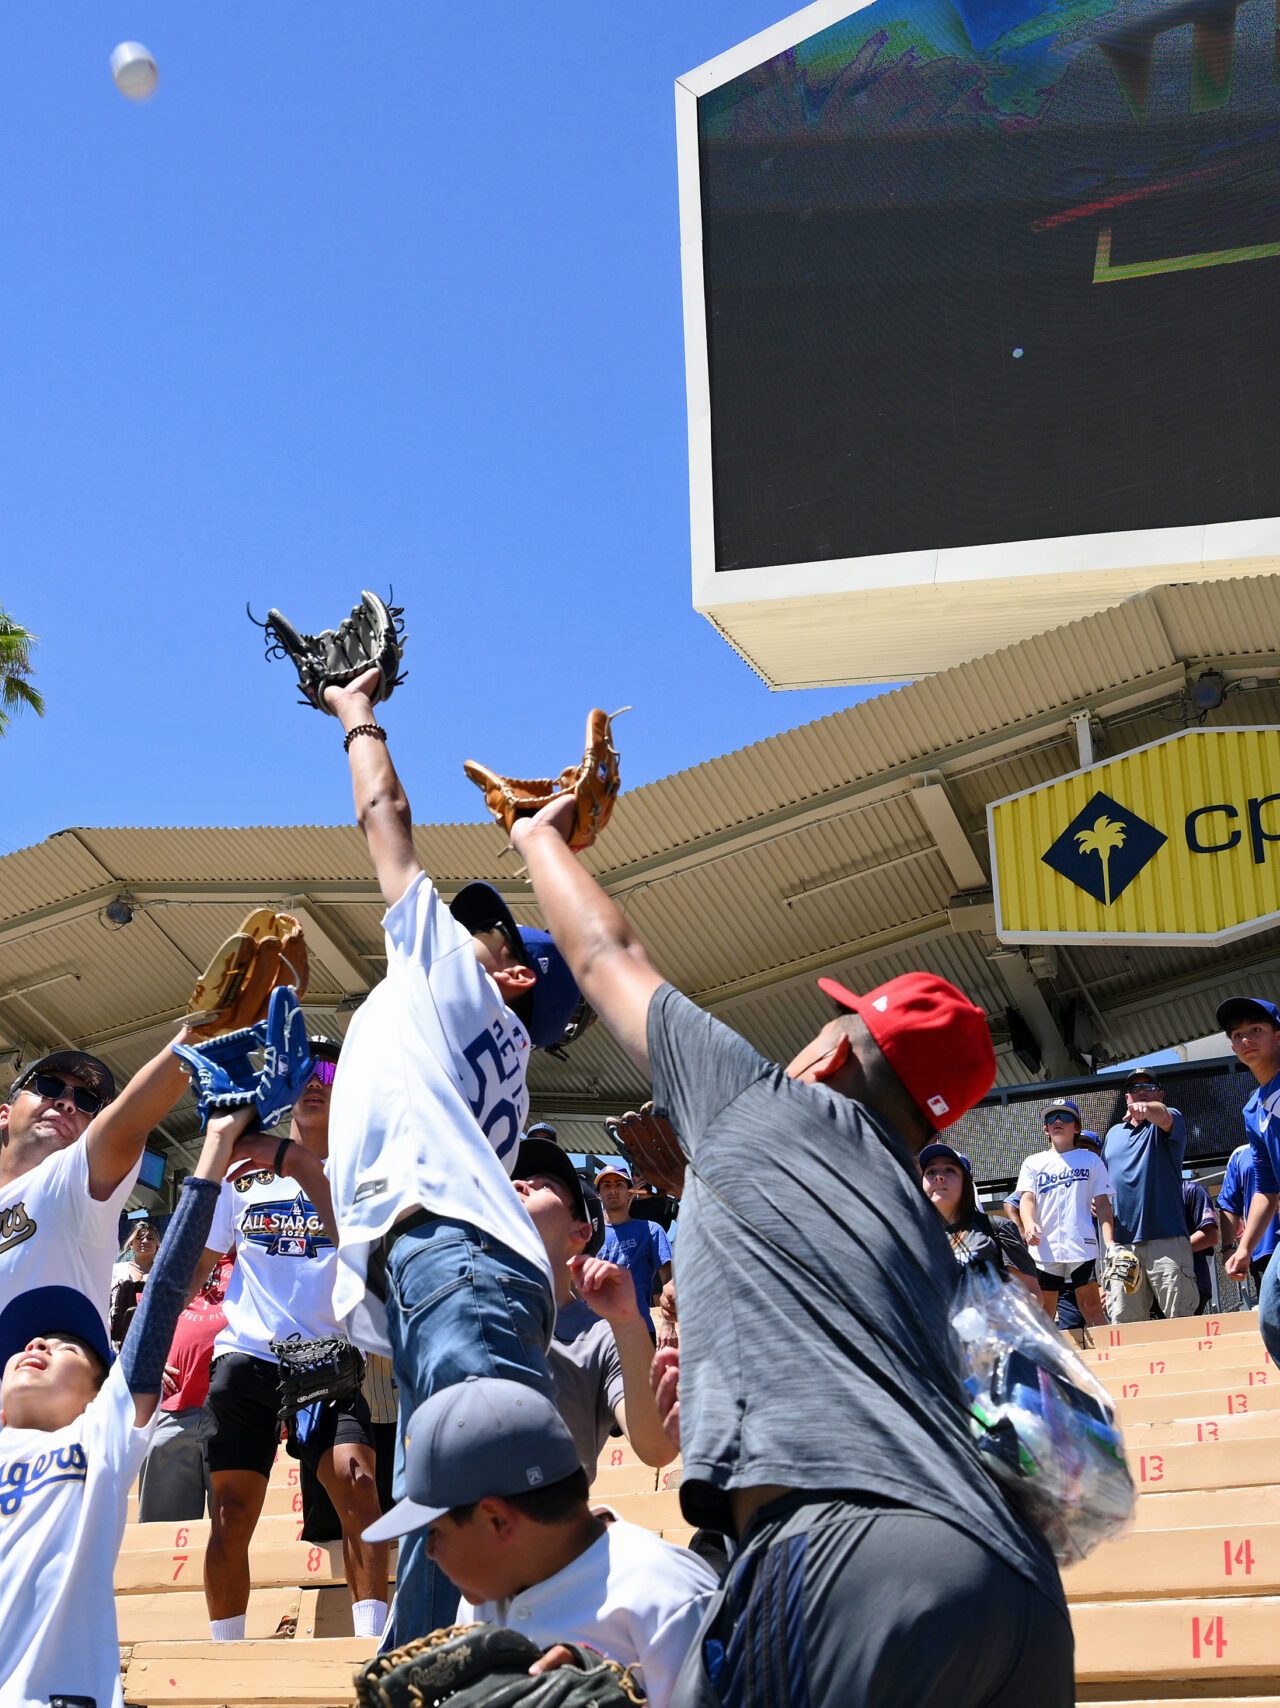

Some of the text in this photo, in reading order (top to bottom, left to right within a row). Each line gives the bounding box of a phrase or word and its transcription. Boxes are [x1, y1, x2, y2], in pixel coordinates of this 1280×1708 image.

[463, 1028, 518, 1160] 50
[1038, 1166, 1090, 1194] Dodgers
[243, 1214, 266, 1230] ALL
[271, 1213, 305, 1229] STAR
[281, 1229, 305, 1238] 2022
[1110, 1330, 1120, 1346] 11
[1206, 1321, 1221, 1337] 12
[1228, 1394, 1247, 1414] 13
[1197, 1422, 1219, 1442] 13
[288, 1468, 299, 1486] 5
[1140, 1455, 1164, 1482] 13
[292, 1493, 303, 1512] 6
[176, 1528, 189, 1547] 6
[307, 1547, 322, 1572] 8
[1224, 1540, 1255, 1575] 14
[173, 1555, 188, 1581] 7
[1192, 1616, 1228, 1658] 14
[409, 1644, 472, 1684] Rawlings
